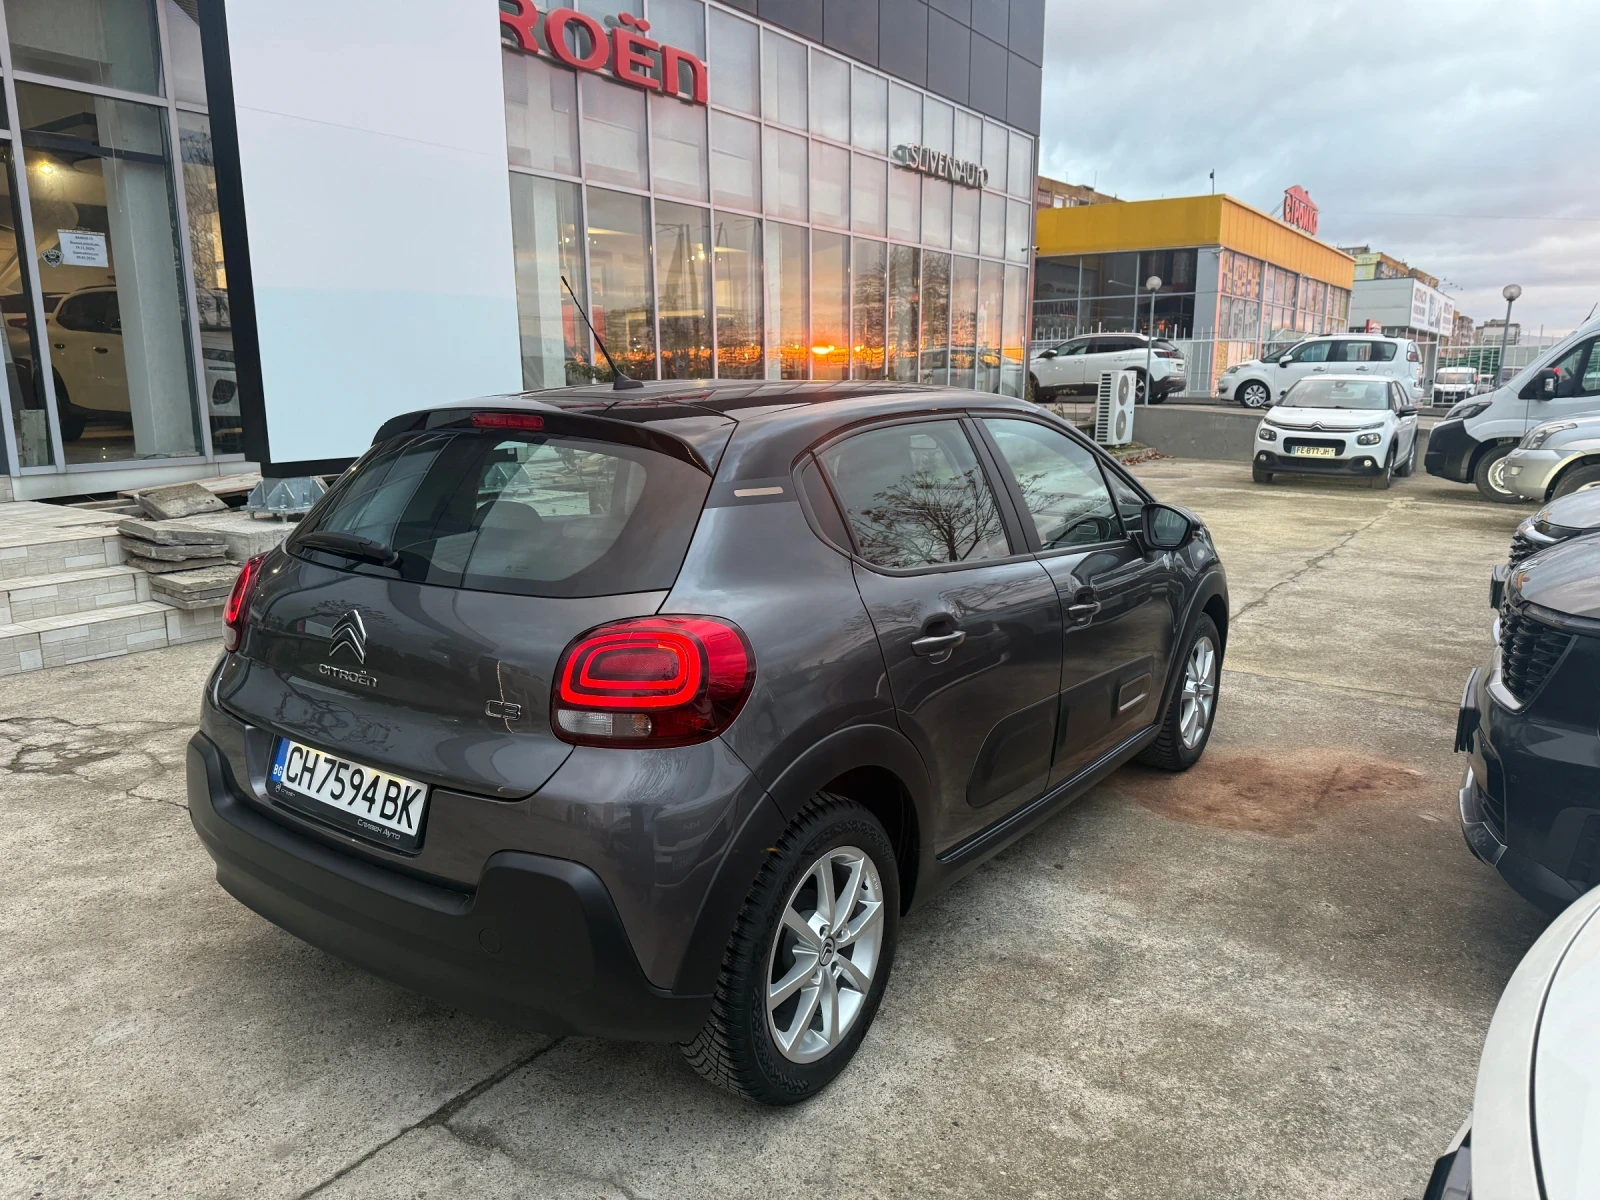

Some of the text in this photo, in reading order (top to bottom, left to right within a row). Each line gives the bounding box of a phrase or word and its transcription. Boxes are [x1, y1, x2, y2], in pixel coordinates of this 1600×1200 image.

[909, 143, 989, 189] SLIVEN AUTO
[318, 663, 378, 688] CITROËN
[484, 699, 521, 721] C3
[272, 763, 283, 777] BG
